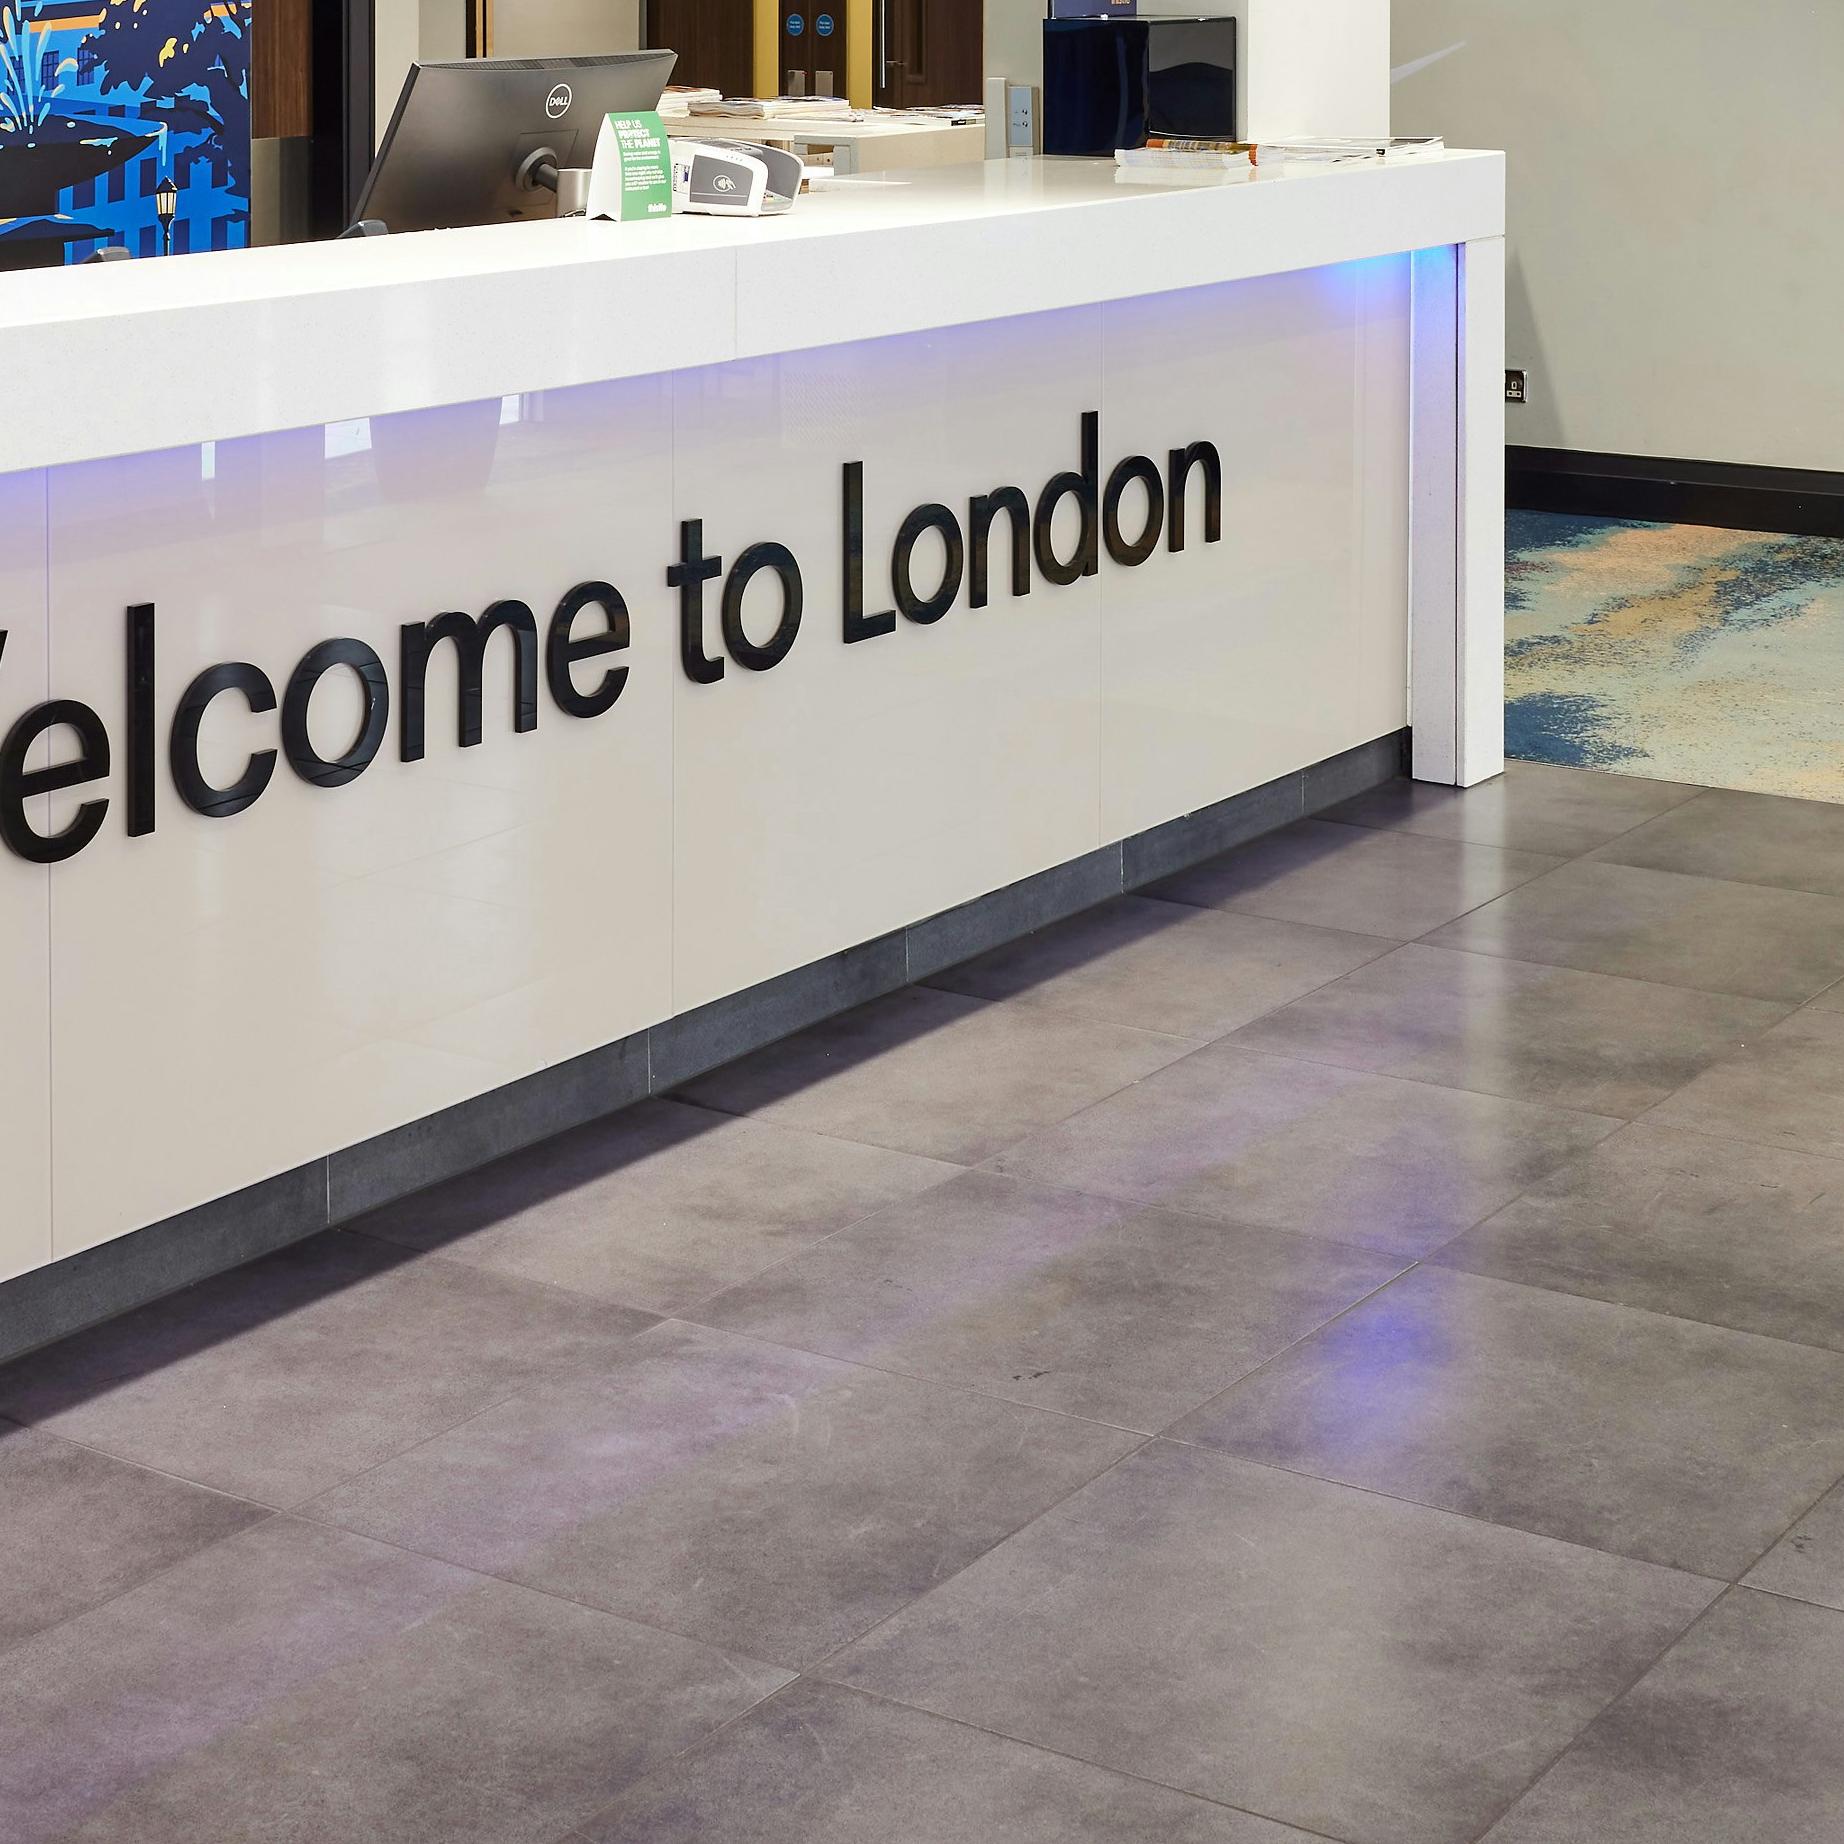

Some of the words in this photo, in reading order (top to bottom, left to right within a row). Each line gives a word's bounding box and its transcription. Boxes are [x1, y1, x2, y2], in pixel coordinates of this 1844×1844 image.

[549, 96, 568, 106] DELL
[614, 119, 632, 130] HELP
[631, 119, 643, 129] US
[617, 128, 650, 139] PROTECT
[620, 139, 634, 149] THE
[634, 138, 661, 148] PLANET
[666, 518, 804, 685] to
[842, 410, 1223, 645] London
